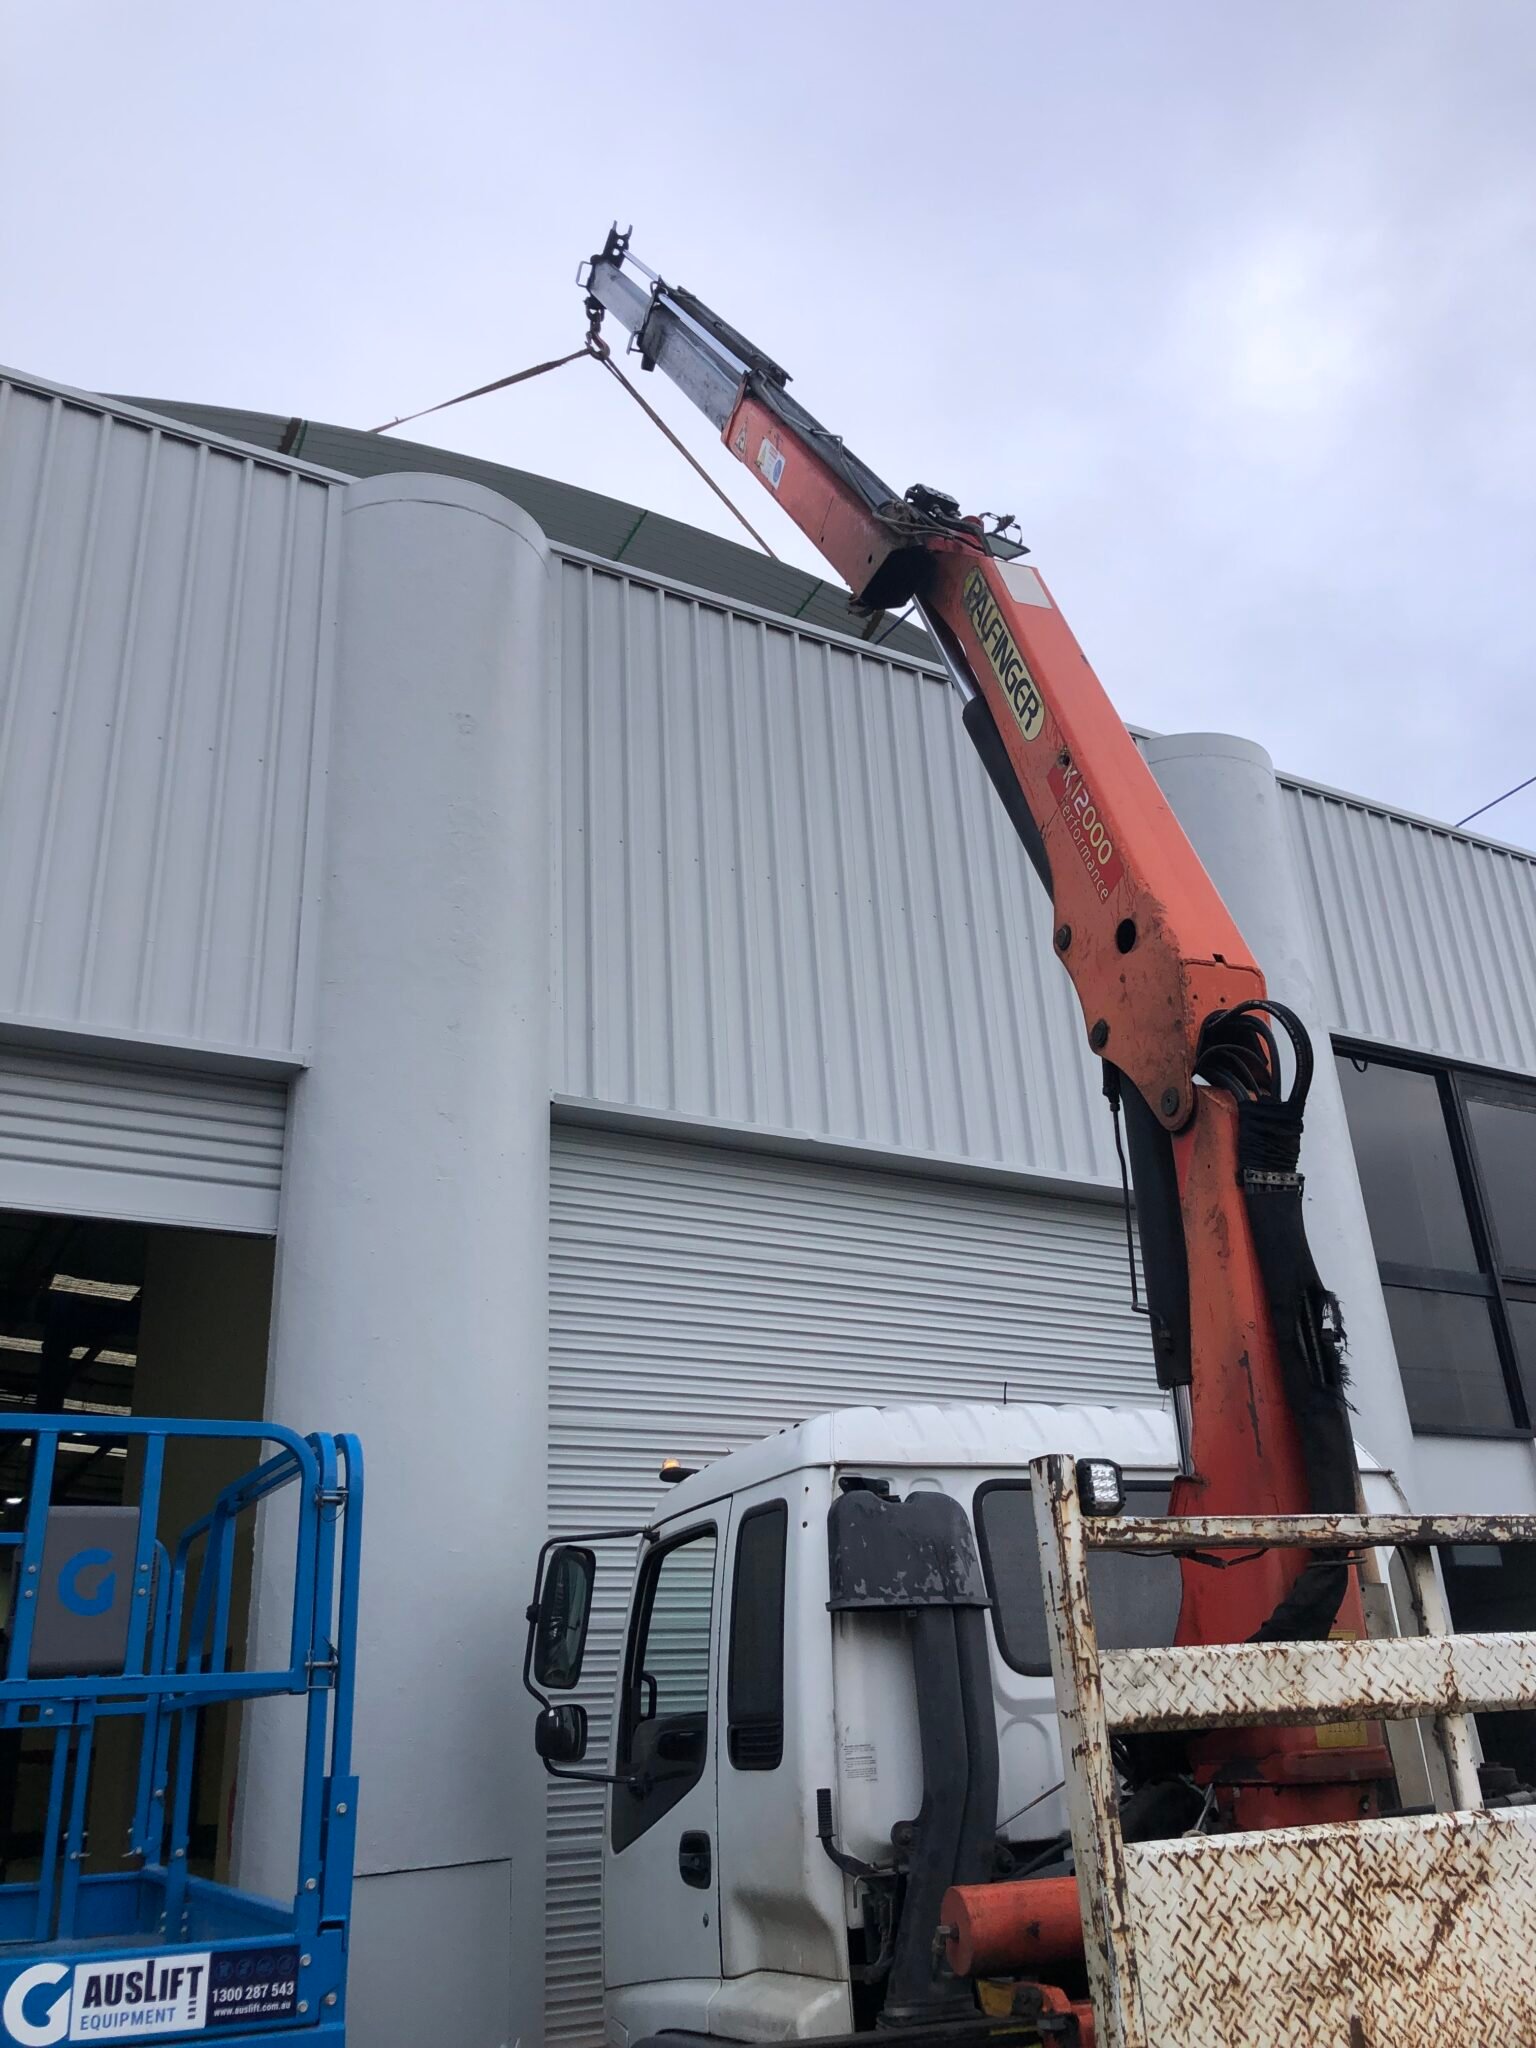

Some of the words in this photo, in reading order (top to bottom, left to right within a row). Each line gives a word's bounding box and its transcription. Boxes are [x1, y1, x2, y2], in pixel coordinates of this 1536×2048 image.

[966, 577, 1040, 732] PALFINGER
[1060, 796, 1109, 900] erformance
[82, 1960, 203, 2009] AUSLIFT
[212, 1986, 243, 2003] 1300
[244, 1983, 269, 2000] 287
[270, 1981, 295, 1997] 543
[80, 2006, 176, 2031] EQUIPMENT
[213, 2001, 291, 2017] www.auslift.com.au
